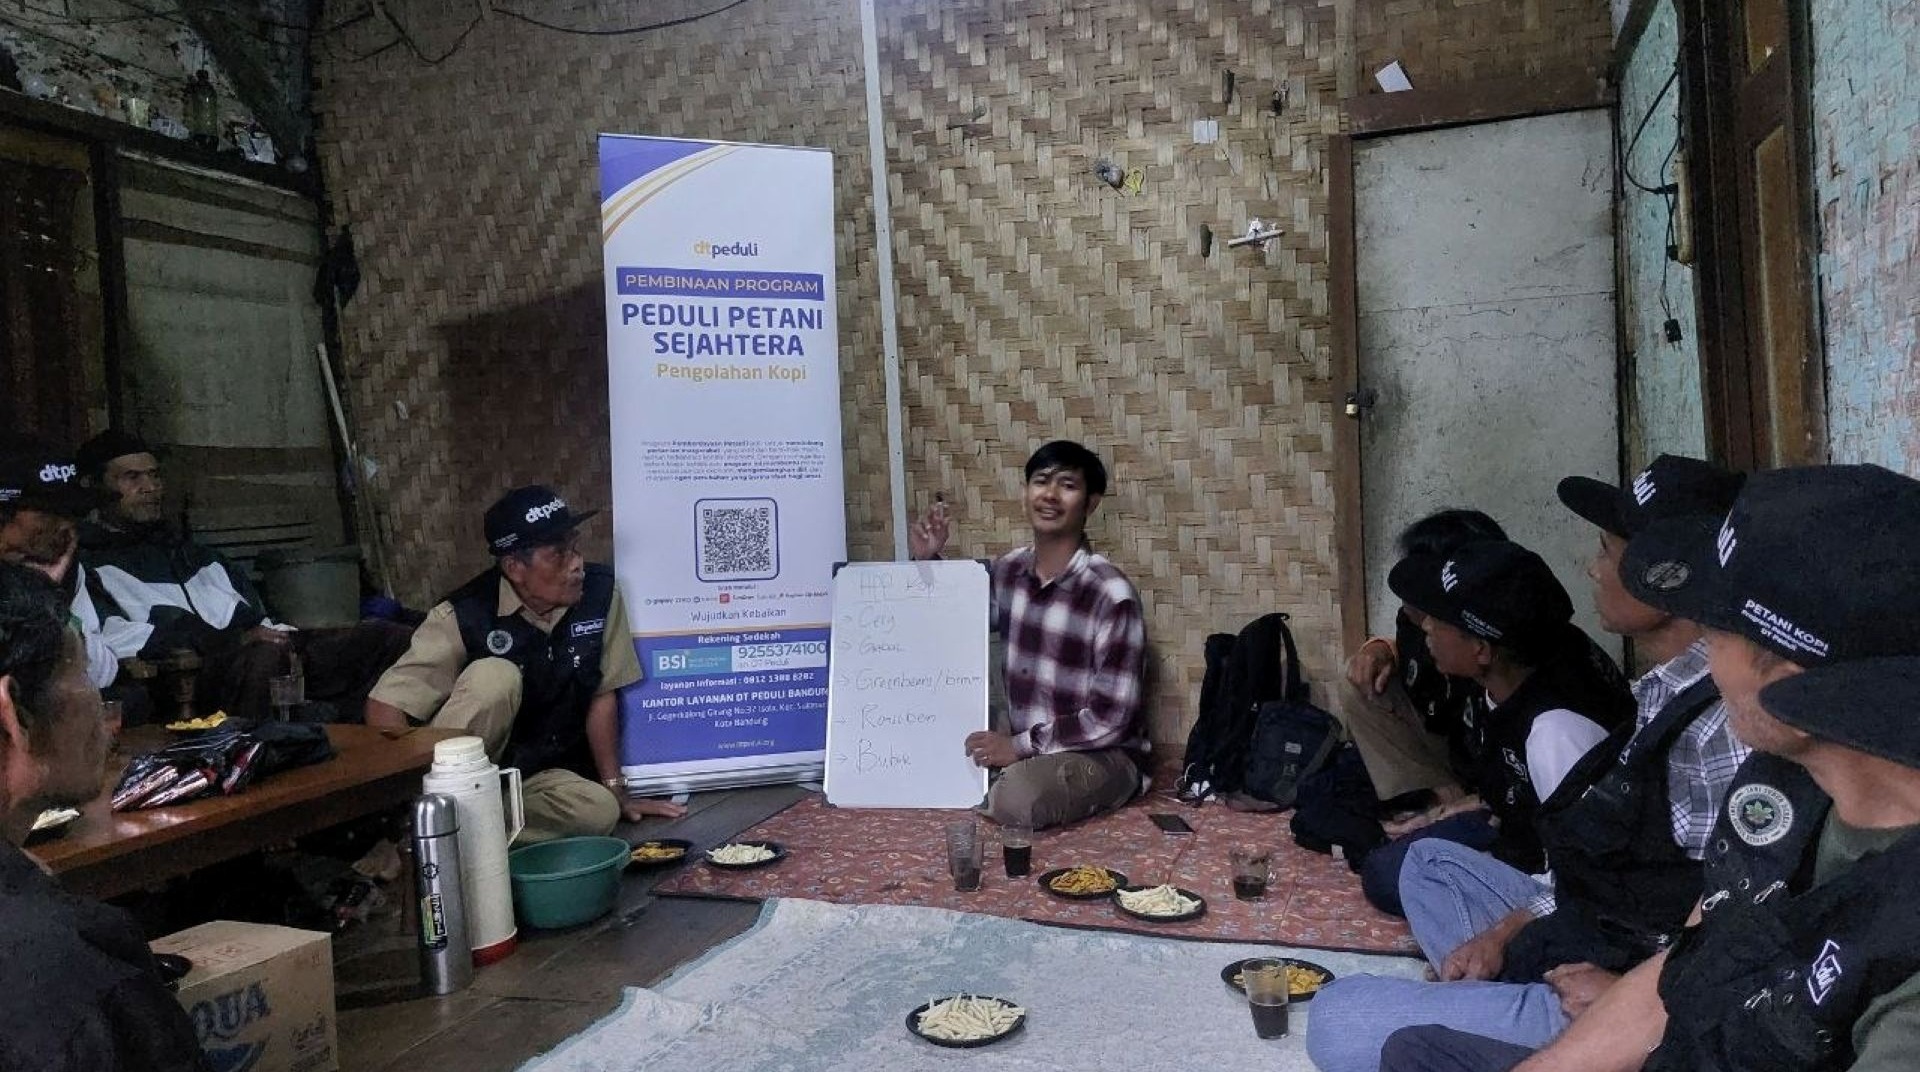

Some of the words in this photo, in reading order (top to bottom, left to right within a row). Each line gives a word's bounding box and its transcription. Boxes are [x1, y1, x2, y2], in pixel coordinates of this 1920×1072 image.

[694, 242, 758, 258] dtpeduli
[625, 274, 730, 290] PEMBINAAN
[735, 279, 818, 293] PROGRAM
[622, 303, 719, 327] PEDULI
[729, 306, 822, 329] PETANI
[653, 332, 804, 359] SEJAHTERA
[657, 363, 762, 382] Pengolahan
[768, 364, 806, 385] Kopi
[690, 611, 740, 622] Wujudkan
[743, 609, 786, 618] Kebaikan
[1745, 599, 1793, 632] PETANI
[1794, 628, 1829, 652] KOPI
[698, 634, 740, 645] Rekening
[742, 632, 781, 641] Sedekah
[659, 655, 686, 670] BSI
[642, 697, 684, 708] KANTOR
[687, 694, 734, 705] LAYANAN
[736, 692, 749, 702] DT
[751, 690, 785, 700] PEDULI
[192, 980, 272, 1042] QUA
